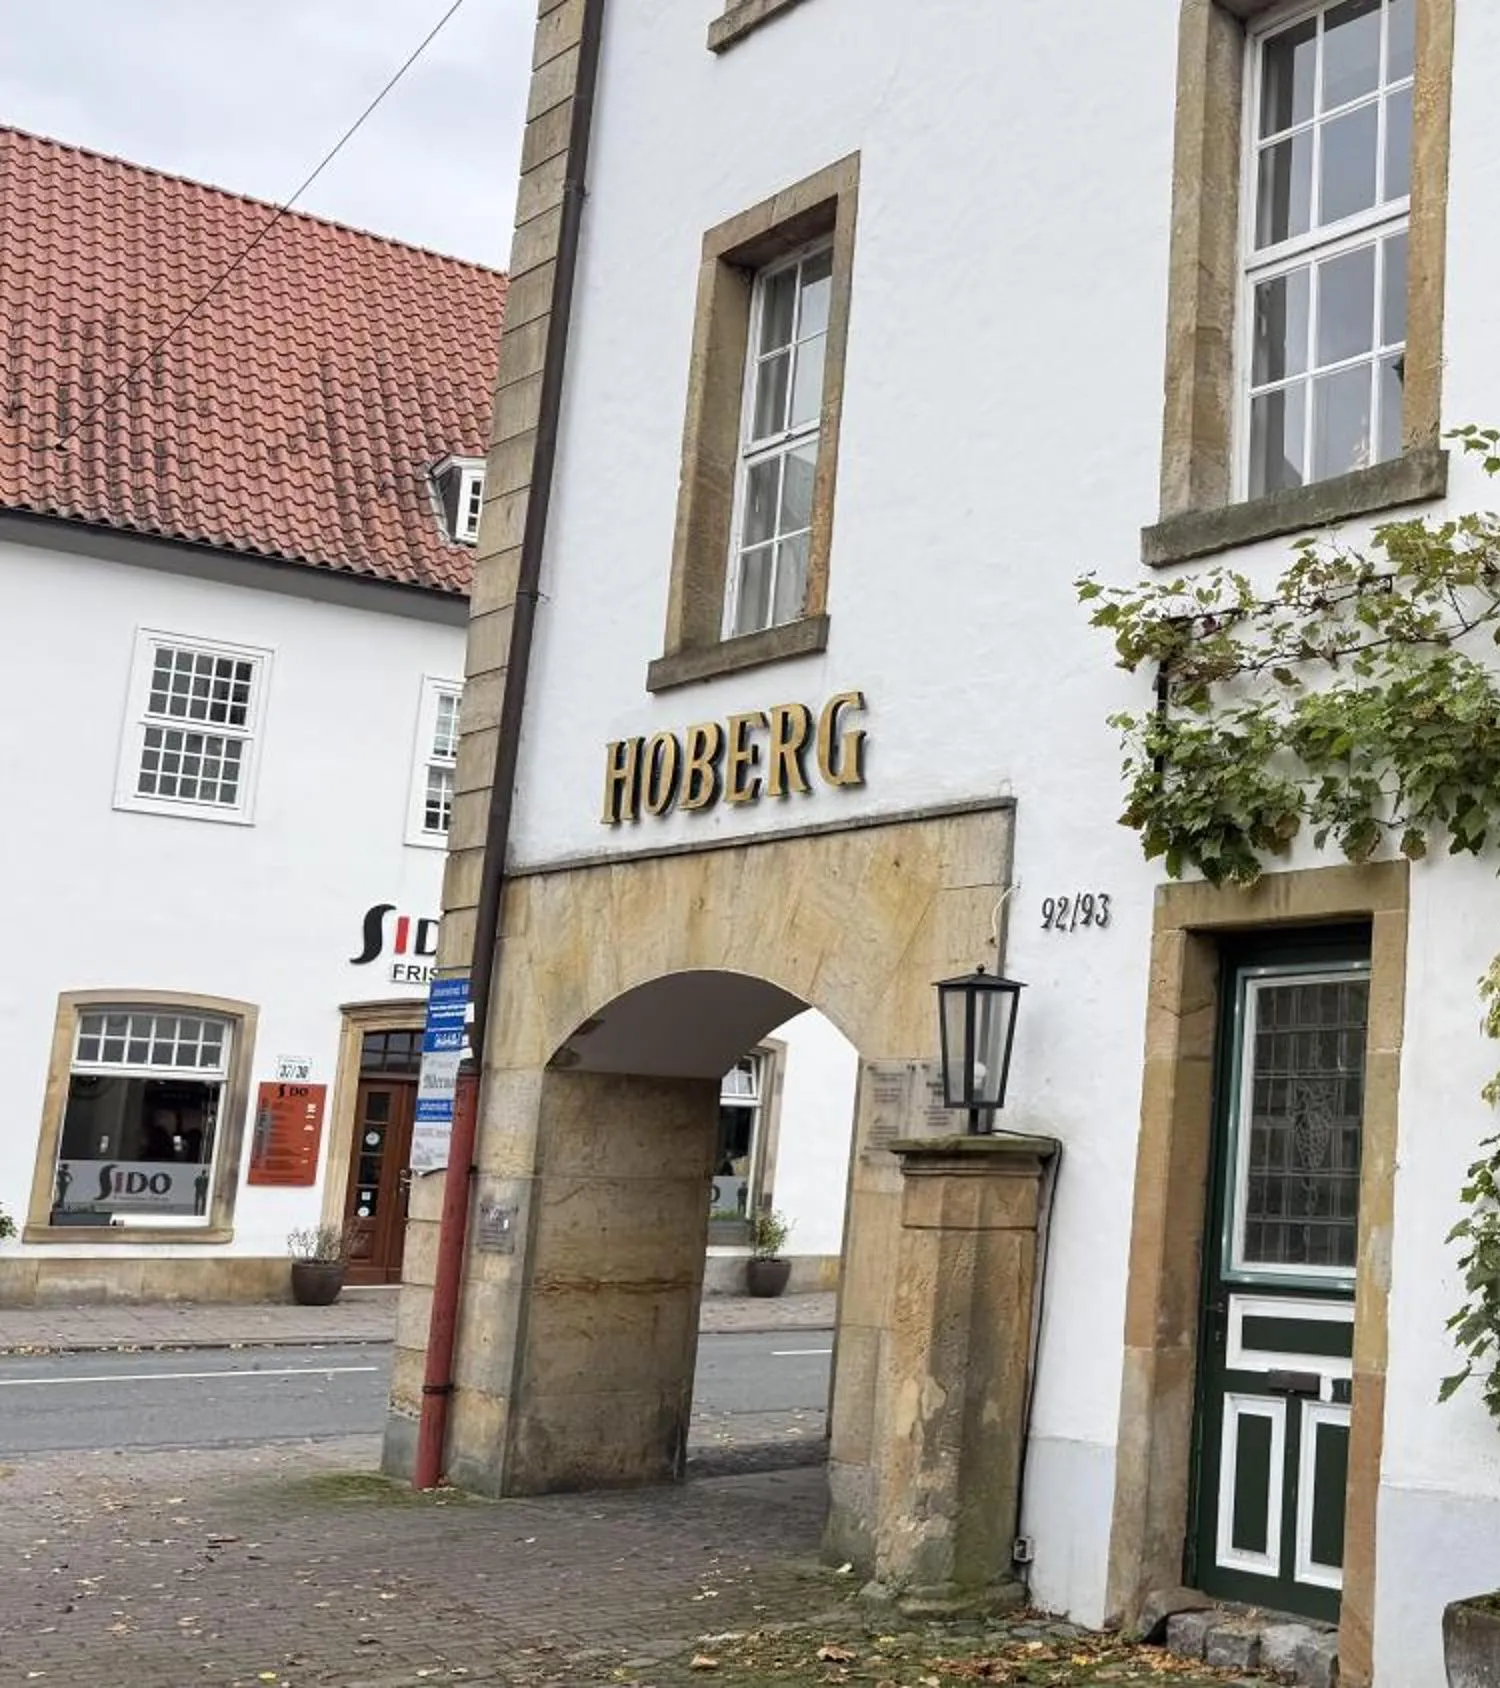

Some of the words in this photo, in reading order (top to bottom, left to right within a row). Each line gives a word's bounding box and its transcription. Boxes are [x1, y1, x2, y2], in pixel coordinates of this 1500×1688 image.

[601, 691, 866, 824] HOBERG
[1041, 892, 1110, 932] 92/93
[94, 1164, 173, 1200] SIDO
